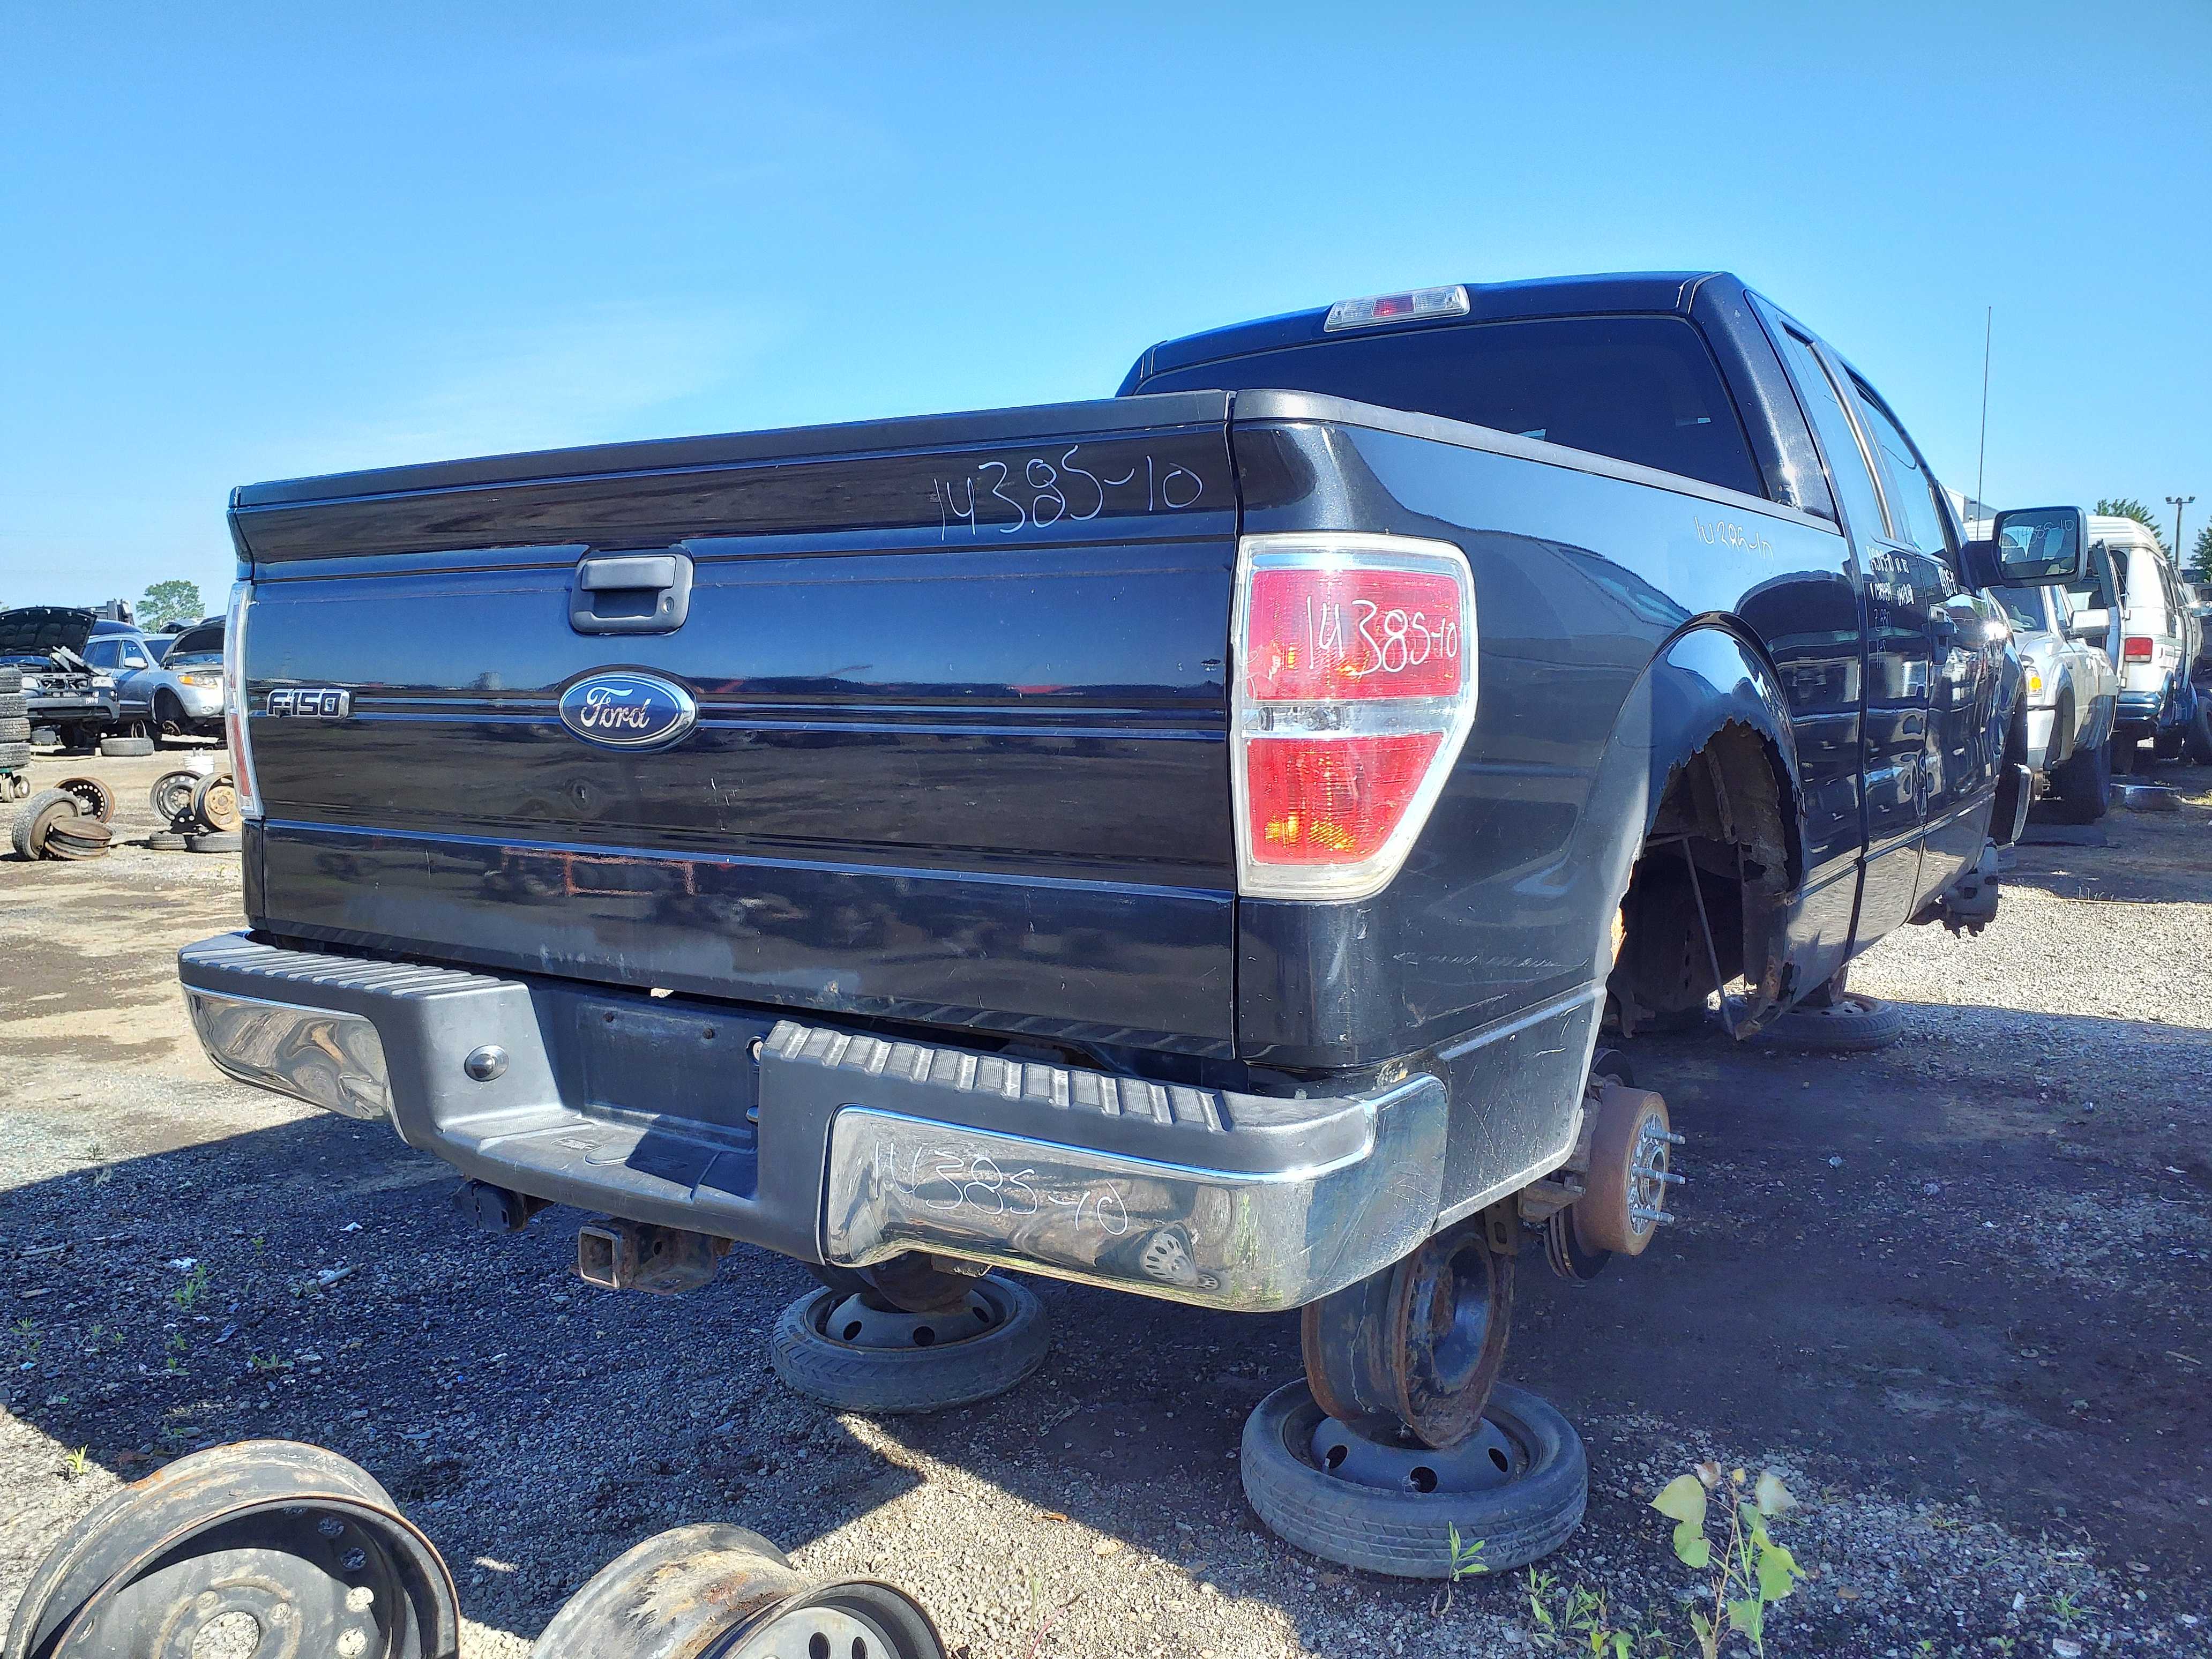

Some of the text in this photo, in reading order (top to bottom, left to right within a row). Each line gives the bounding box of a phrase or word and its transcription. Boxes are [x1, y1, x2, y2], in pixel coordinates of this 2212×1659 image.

[933, 444, 1203, 541] 14385-10
[1306, 595, 1458, 677] 14385-10
[580, 686, 652, 728] Ford
[874, 1140, 1129, 1235] 14385-10
